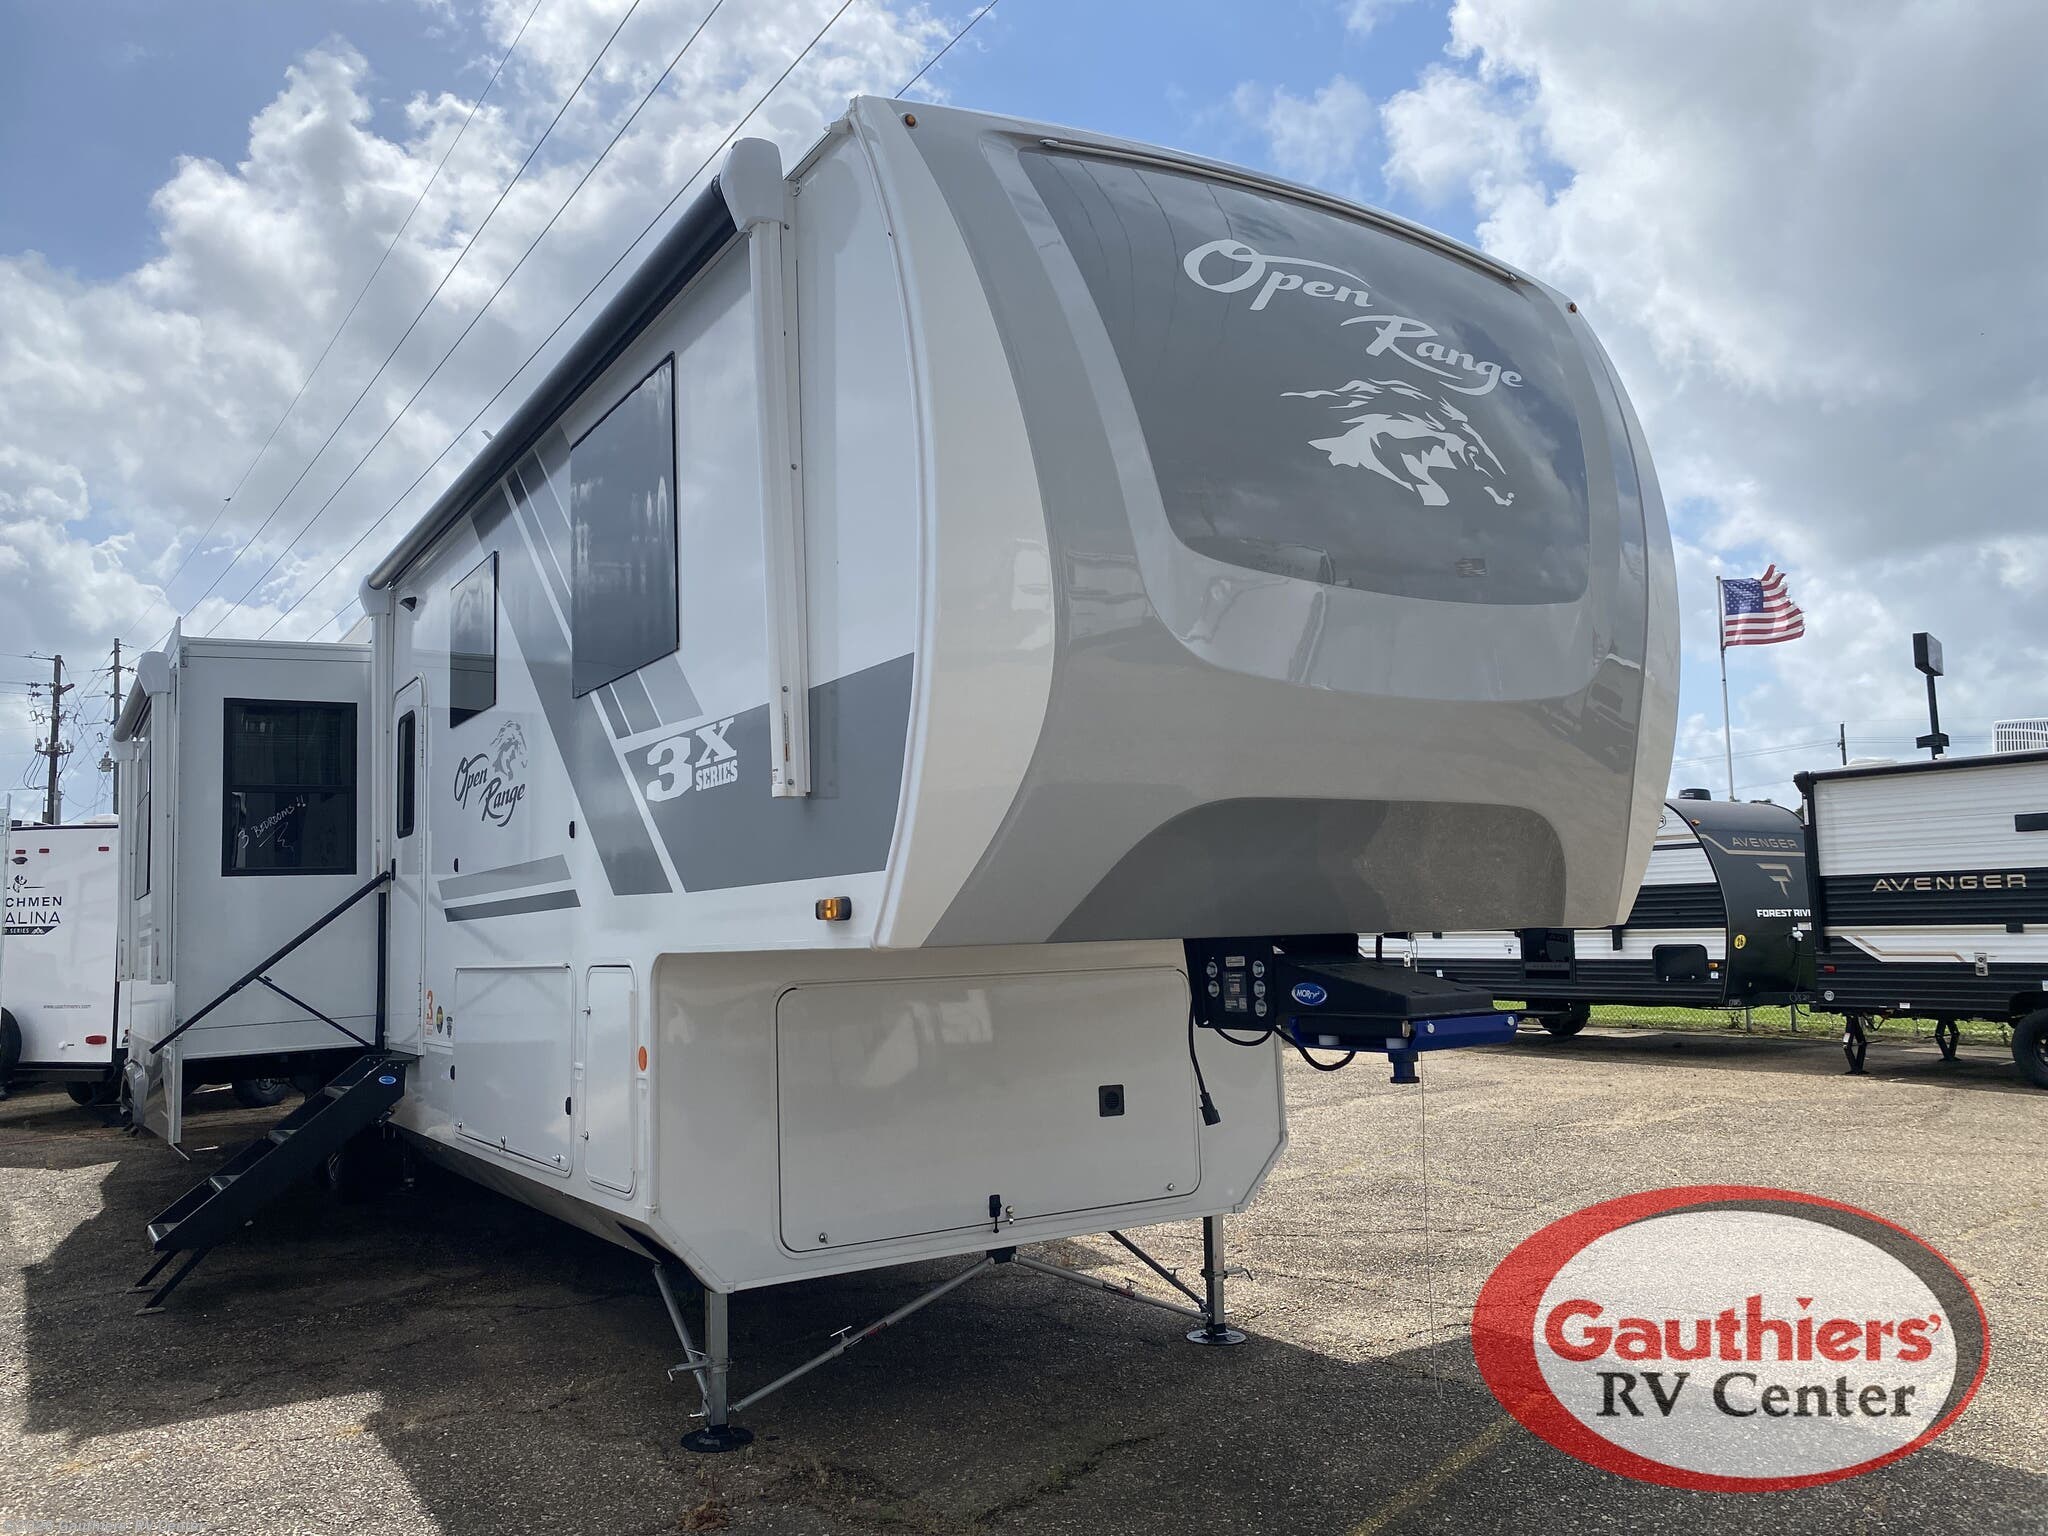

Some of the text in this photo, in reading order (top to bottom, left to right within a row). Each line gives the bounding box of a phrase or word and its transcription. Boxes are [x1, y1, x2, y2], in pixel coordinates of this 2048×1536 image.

[1183, 238, 1374, 311] Open
[1340, 314, 1524, 396] Range
[454, 752, 490, 810] Open
[695, 759, 738, 792] SERIES
[478, 776, 526, 828] Range
[237, 827, 250, 849] 3
[1731, 836, 1799, 849] AVENGER
[1871, 873, 2028, 892] AVENGER
[1756, 908, 1792, 918] FOREST
